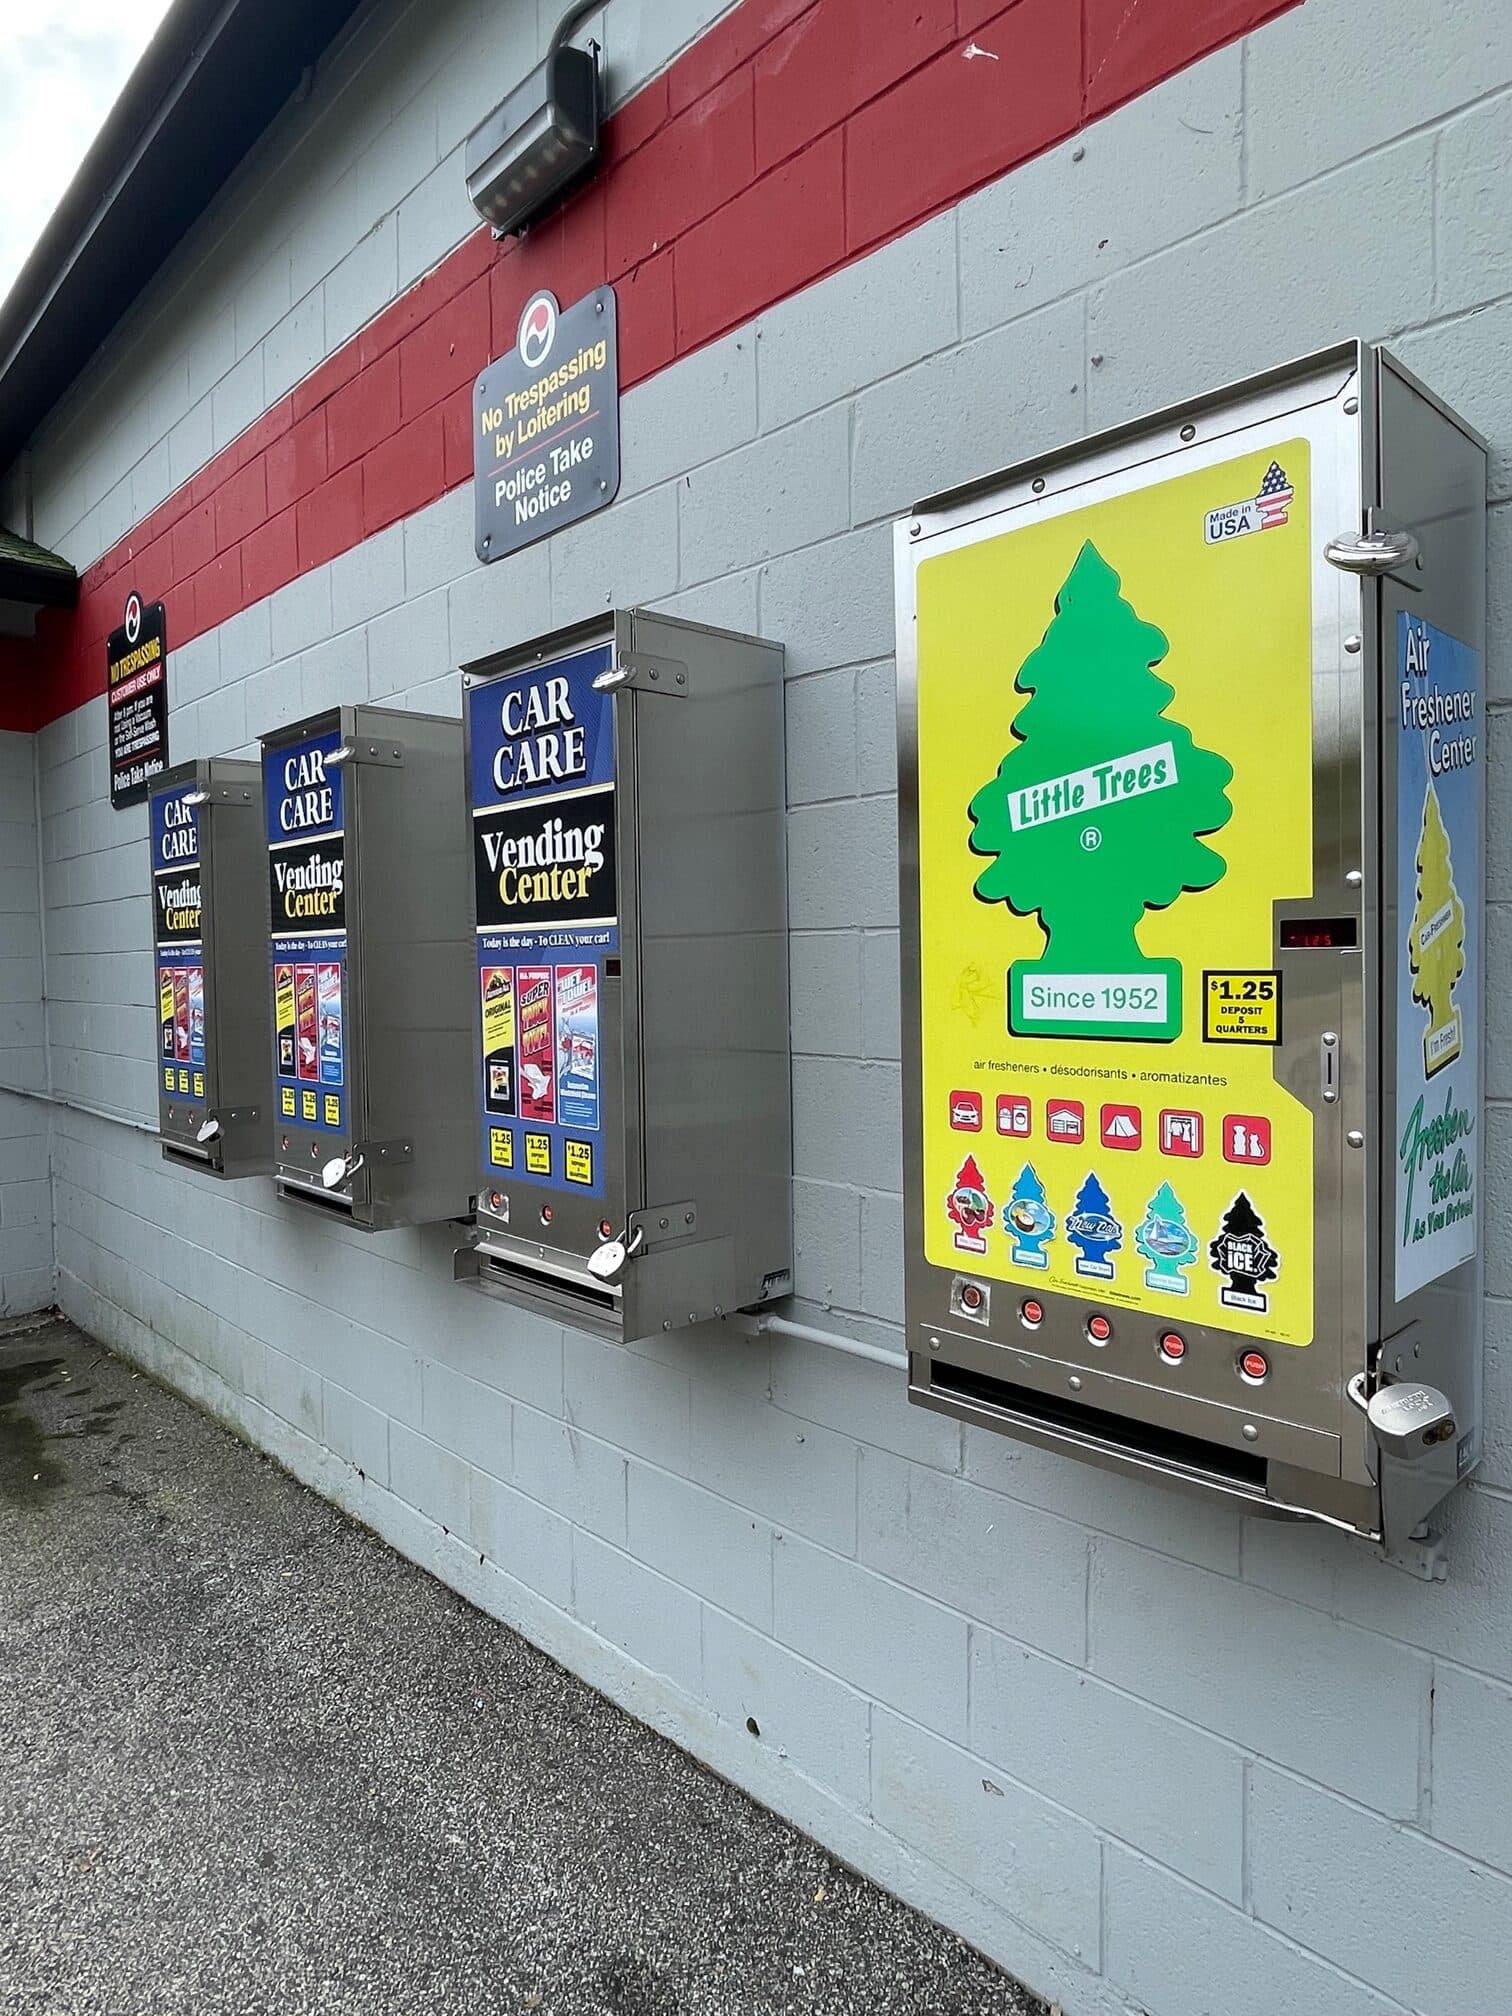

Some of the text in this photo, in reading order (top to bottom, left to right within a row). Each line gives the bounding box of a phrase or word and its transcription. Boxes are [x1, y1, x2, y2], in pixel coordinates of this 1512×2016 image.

[482, 339, 607, 436] No Trespassing
[495, 383, 591, 459] by Loitering
[495, 436, 594, 507] Police Take
[514, 480, 572, 526] Notice
[1209, 504, 1251, 523] Made in
[1210, 515, 1250, 540] USA
[120, 636, 160, 678] TRESPASSING
[1406, 627, 1430, 673] Air
[147, 664, 161, 684] ONLY
[501, 676, 574, 738] CAR
[1401, 681, 1476, 727] Freshener
[493, 726, 587, 792] CARE
[1429, 730, 1477, 774] Center
[114, 758, 163, 792] Police Take Notice
[284, 749, 327, 792] CAR
[1019, 759, 1167, 826] Little Trees
[164, 799, 193, 829] CAR
[280, 787, 333, 832] CARE
[162, 827, 197, 860] CARE
[481, 816, 605, 873] Vending
[273, 853, 344, 895] Vending
[499, 862, 593, 907] Center
[165, 907, 201, 931] Center
[284, 887, 338, 919] Center
[482, 936, 501, 951] Today
[502, 936, 509, 948] is
[509, 935, 520, 948] the
[520, 935, 533, 950] day
[538, 934, 548, 947] To
[548, 934, 575, 947] CLEAN
[574, 934, 594, 948] your
[594, 931, 610, 944] car!
[520, 980, 550, 1005] SUPER
[1030, 985, 1159, 1010] Since 1952
[1210, 980, 1274, 1001] $1.25
[485, 999, 512, 1019] ORIGINAL
[1220, 1006, 1263, 1015] DEPOSIT
[1238, 1016, 1244, 1024] 5
[1215, 1024, 1268, 1034] QUARTERS
[973, 1059, 1228, 1087] air fresheners désodorisants aromatizantes
[492, 1131, 511, 1145] $1.25
[527, 1137, 548, 1151] $1.25
[567, 1144, 590, 1160] $1.25
[1400, 1086, 1475, 1248] Freshen
[1429, 1148, 1474, 1206] the Air
[1068, 1216, 1118, 1234] New Car
[1412, 1192, 1474, 1244] As You Drive!
[1227, 1241, 1253, 1253] BLACK
